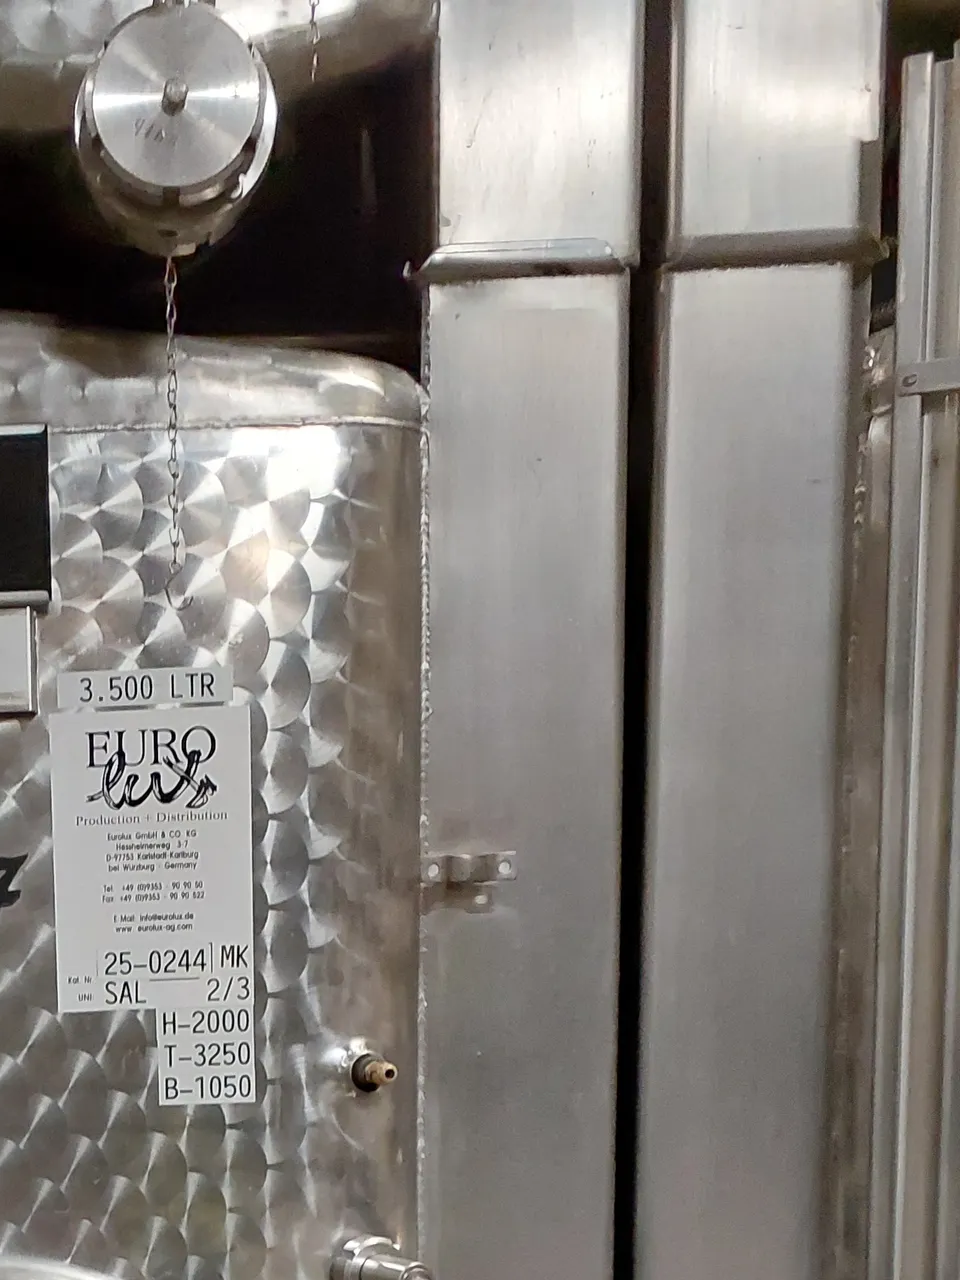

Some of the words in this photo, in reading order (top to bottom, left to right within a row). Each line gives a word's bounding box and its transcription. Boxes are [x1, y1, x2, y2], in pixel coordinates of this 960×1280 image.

[80, 675, 153, 702] 3.500
[171, 673, 215, 698] LTR
[85, 726, 216, 769] EURO
[76, 814, 140, 827] Production
[156, 810, 228, 823] Distribution
[107, 832, 132, 841] Eurolux
[135, 830, 158, 840] GmbH
[185, 829, 197, 838] KG
[108, 863, 120, 872] bei
[164, 860, 197, 870] Germany
[169, 891, 178, 900] 90
[181, 891, 190, 900] 90
[171, 881, 181, 890] 90
[183, 880, 192, 890] 90
[139, 911, 194, 923] info@eurolux.de
[104, 948, 207, 976] 25-0244
[220, 945, 249, 968] MK
[105, 980, 147, 1005] SAL
[207, 976, 250, 1002] 2/3
[162, 1008, 250, 1035] H-2000
[163, 1041, 251, 1068] T-3250
[164, 1074, 252, 1101] B-1050
